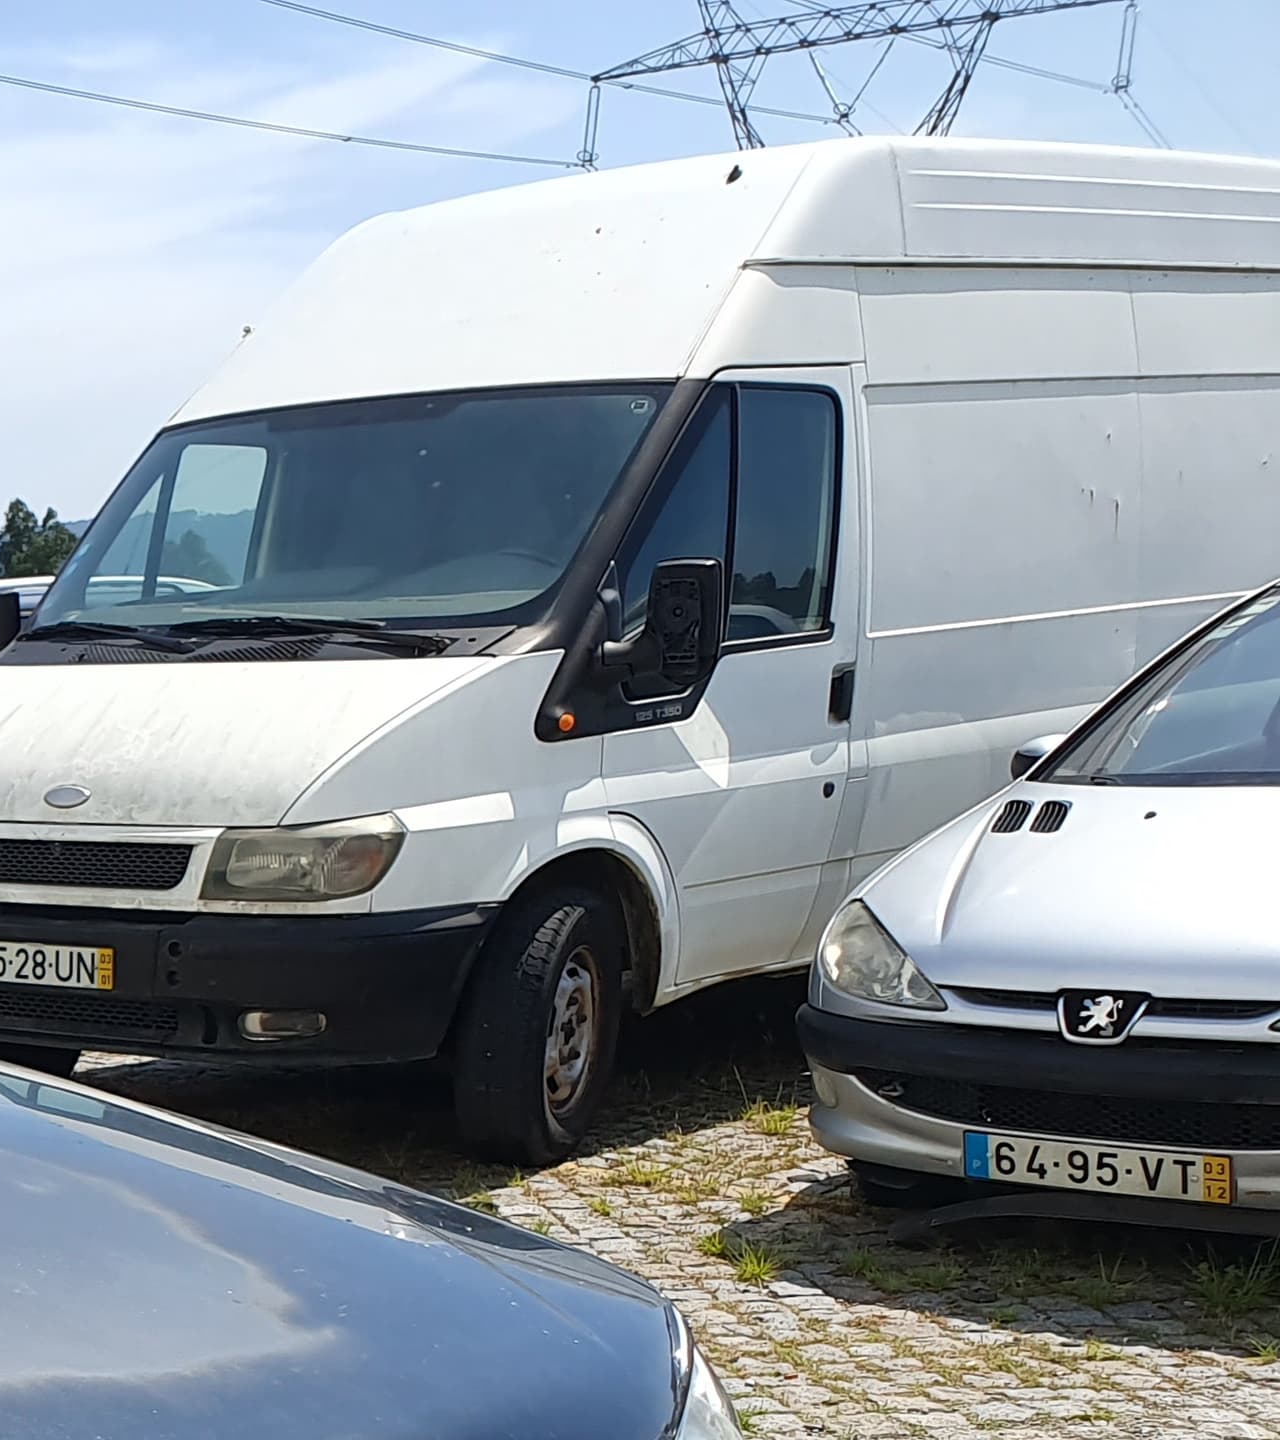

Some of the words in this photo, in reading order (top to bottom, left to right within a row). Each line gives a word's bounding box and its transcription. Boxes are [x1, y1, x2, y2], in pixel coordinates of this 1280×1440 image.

[99, 953, 112, 965] 03
[100, 974, 111, 985] 01
[1203, 1161, 1226, 1175] 03
[1204, 1185, 1227, 1199] 12
